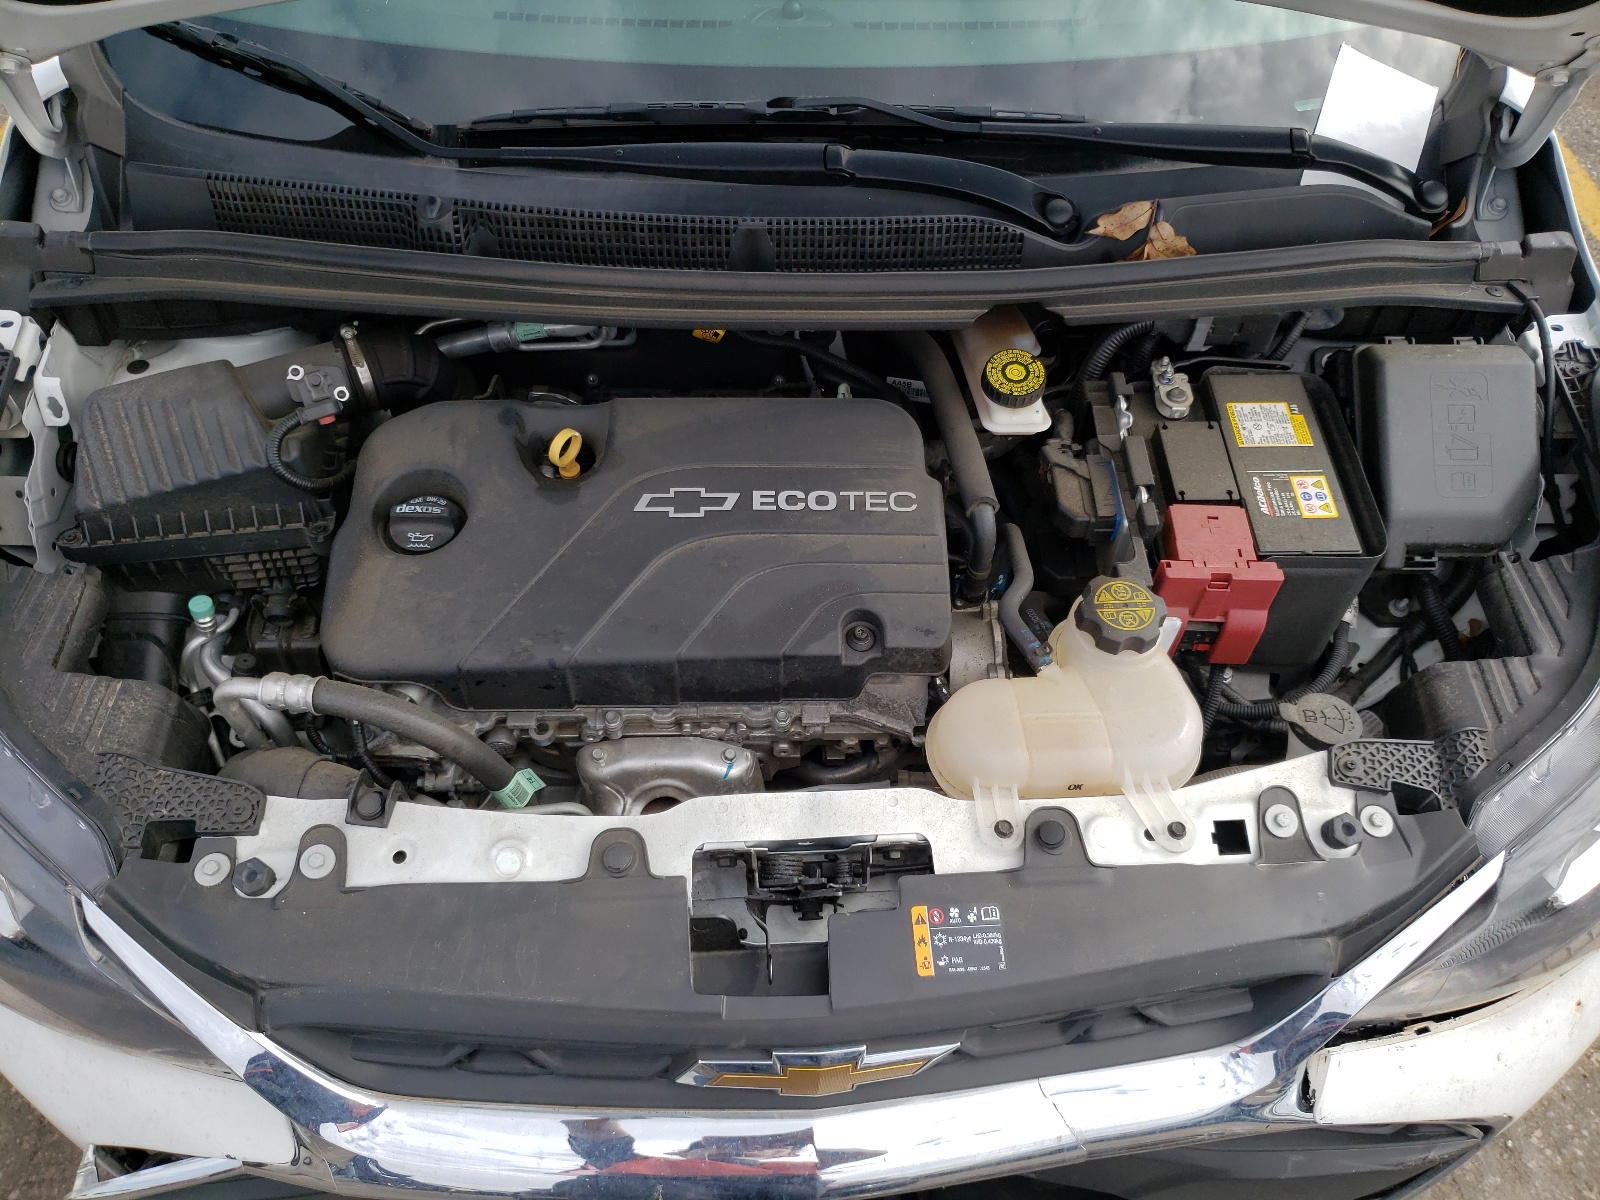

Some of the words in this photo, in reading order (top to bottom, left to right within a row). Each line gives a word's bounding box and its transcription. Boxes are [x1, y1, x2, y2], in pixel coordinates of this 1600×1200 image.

[752, 490, 918, 512] ECOTEC
[395, 503, 442, 514] dexos
[1067, 783, 1084, 791] OK
